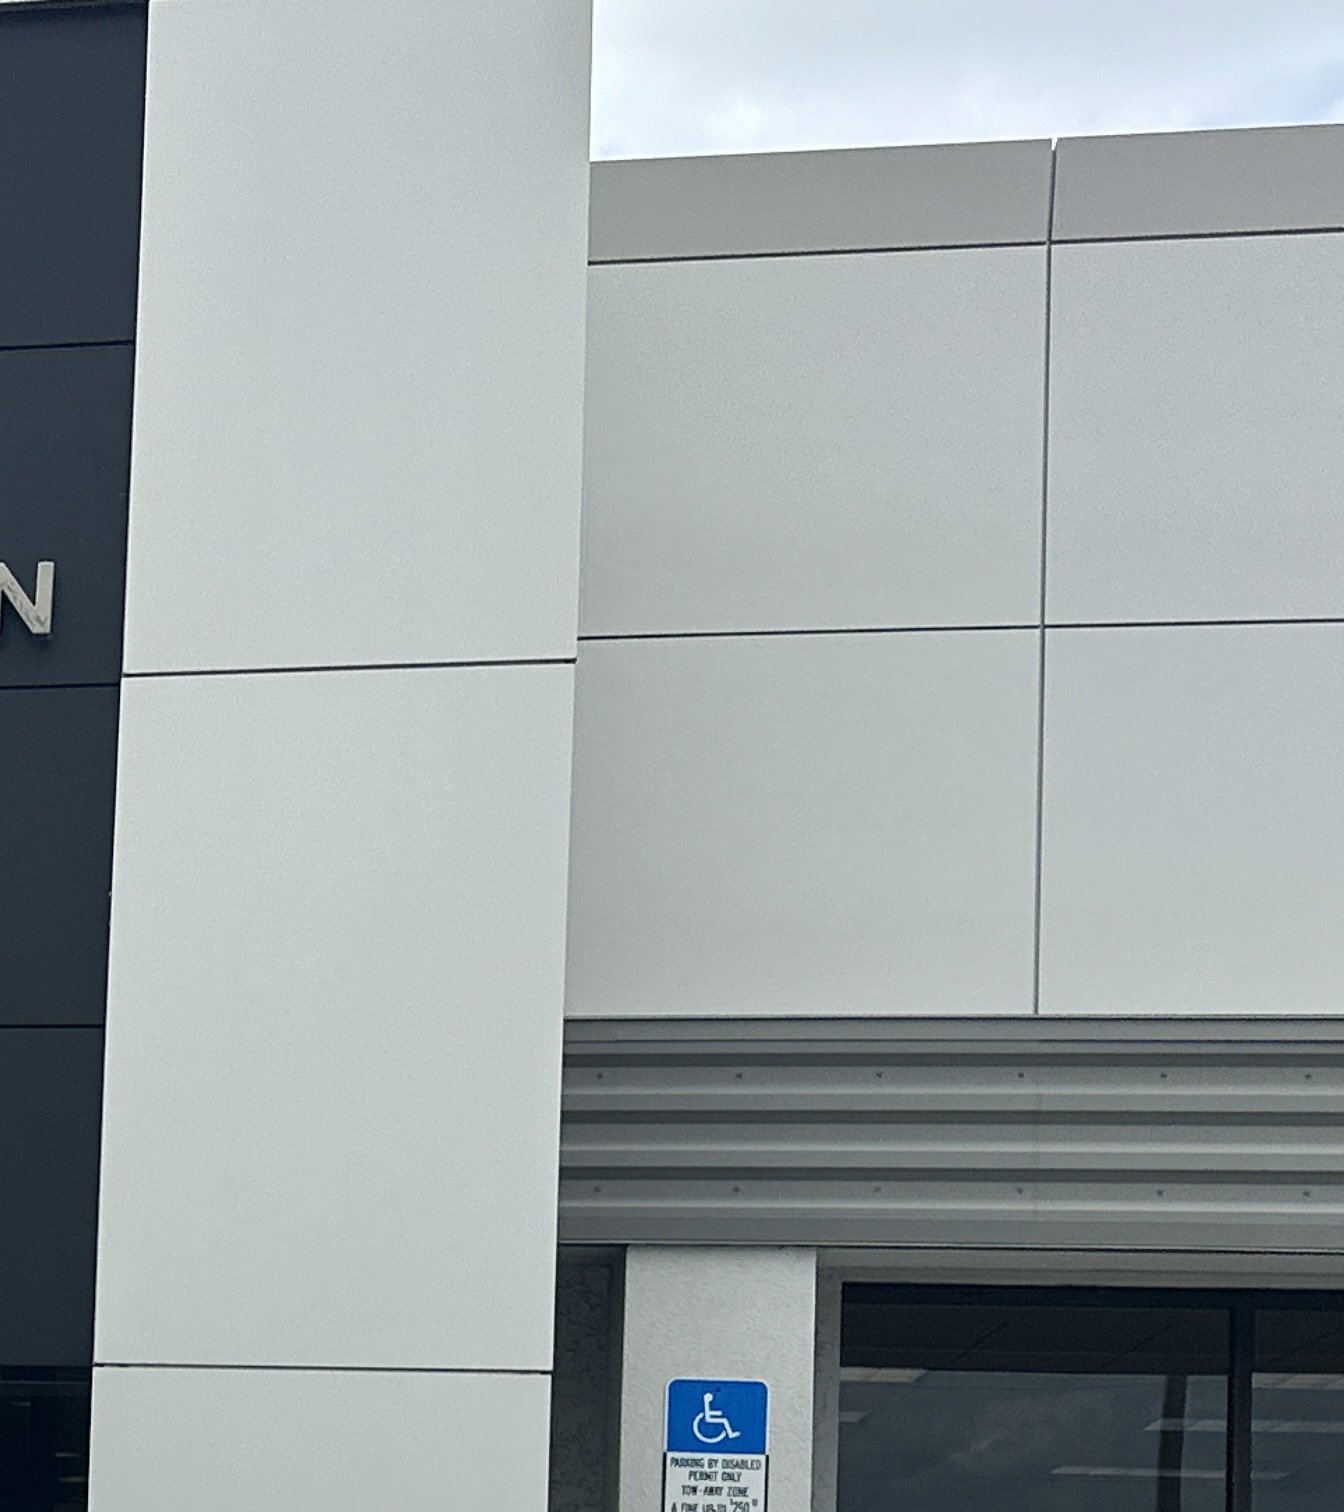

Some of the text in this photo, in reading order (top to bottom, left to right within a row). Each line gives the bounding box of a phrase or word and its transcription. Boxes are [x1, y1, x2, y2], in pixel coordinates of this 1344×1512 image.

[670, 1457, 761, 1470] PARKING BY DISABLED
[688, 1470, 742, 1482] PERMIT ONLY
[727, 1487, 749, 1497] ZONE
